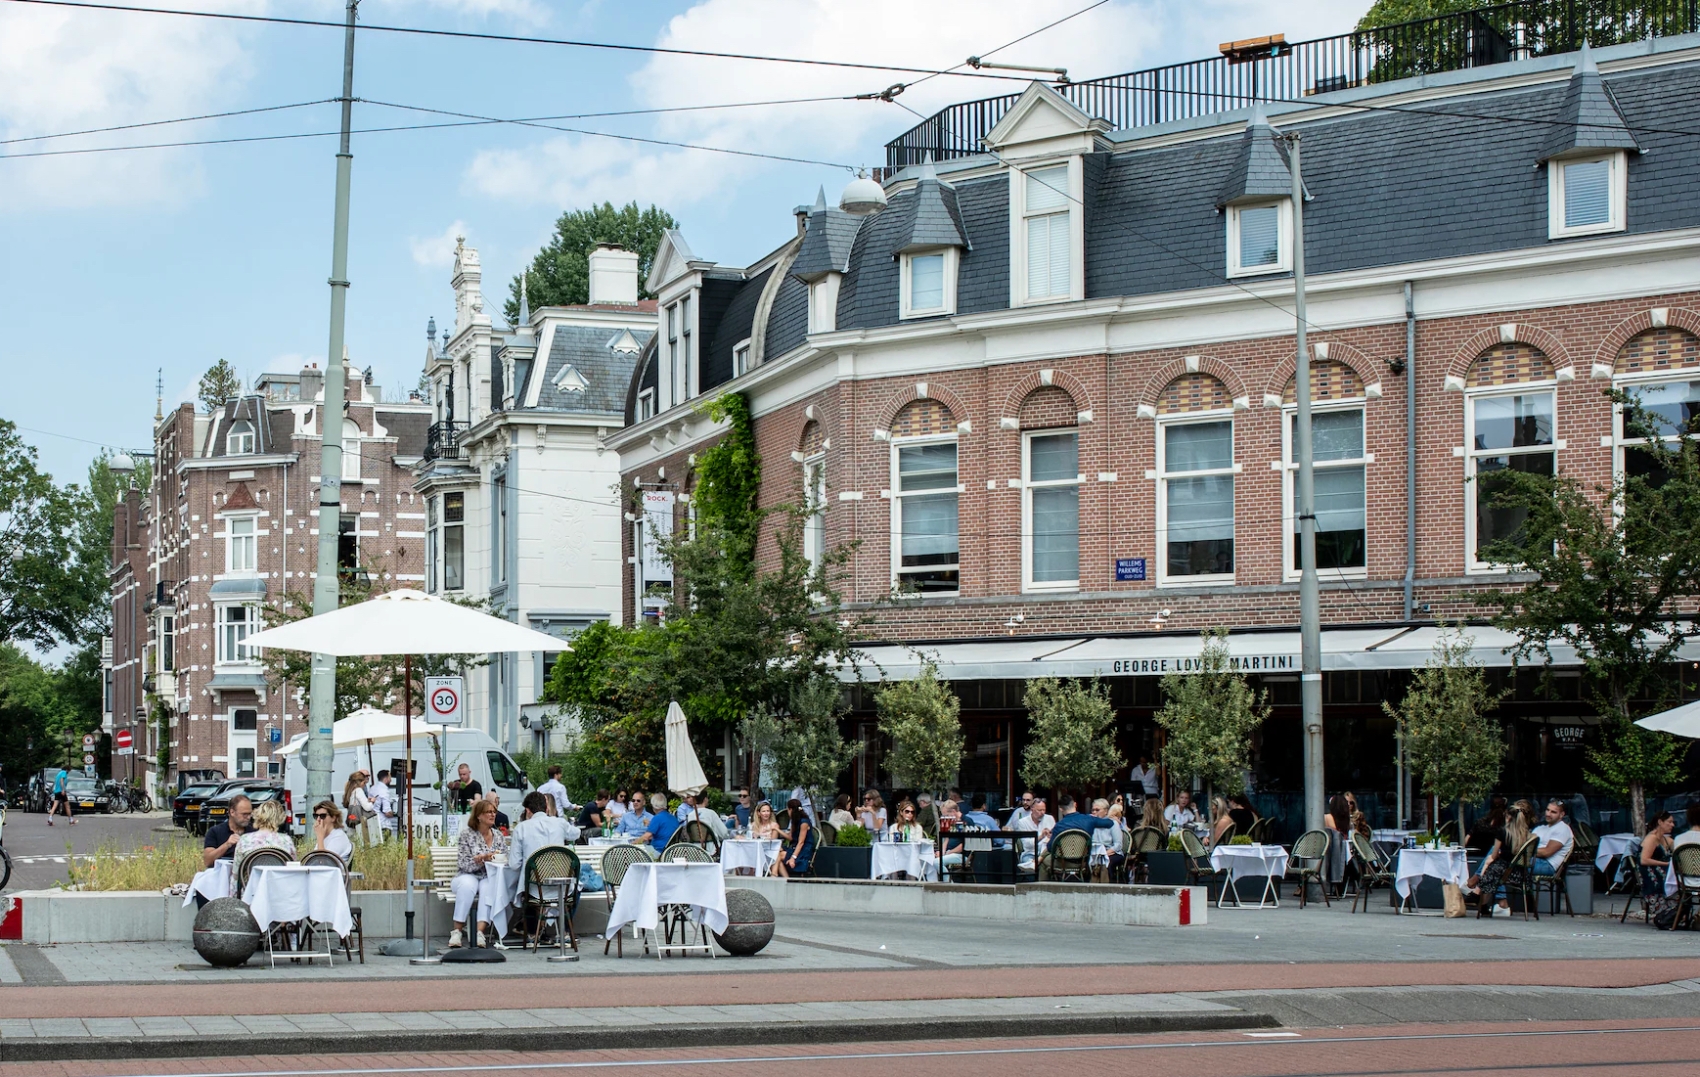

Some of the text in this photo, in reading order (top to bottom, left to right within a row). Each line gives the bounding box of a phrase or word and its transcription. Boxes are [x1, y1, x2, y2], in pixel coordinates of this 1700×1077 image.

[1113, 659, 1167, 673] GEORGE
[1229, 655, 1293, 670] MARTINI
[436, 695, 453, 706] 30
[1554, 727, 1585, 738] GEORGE
